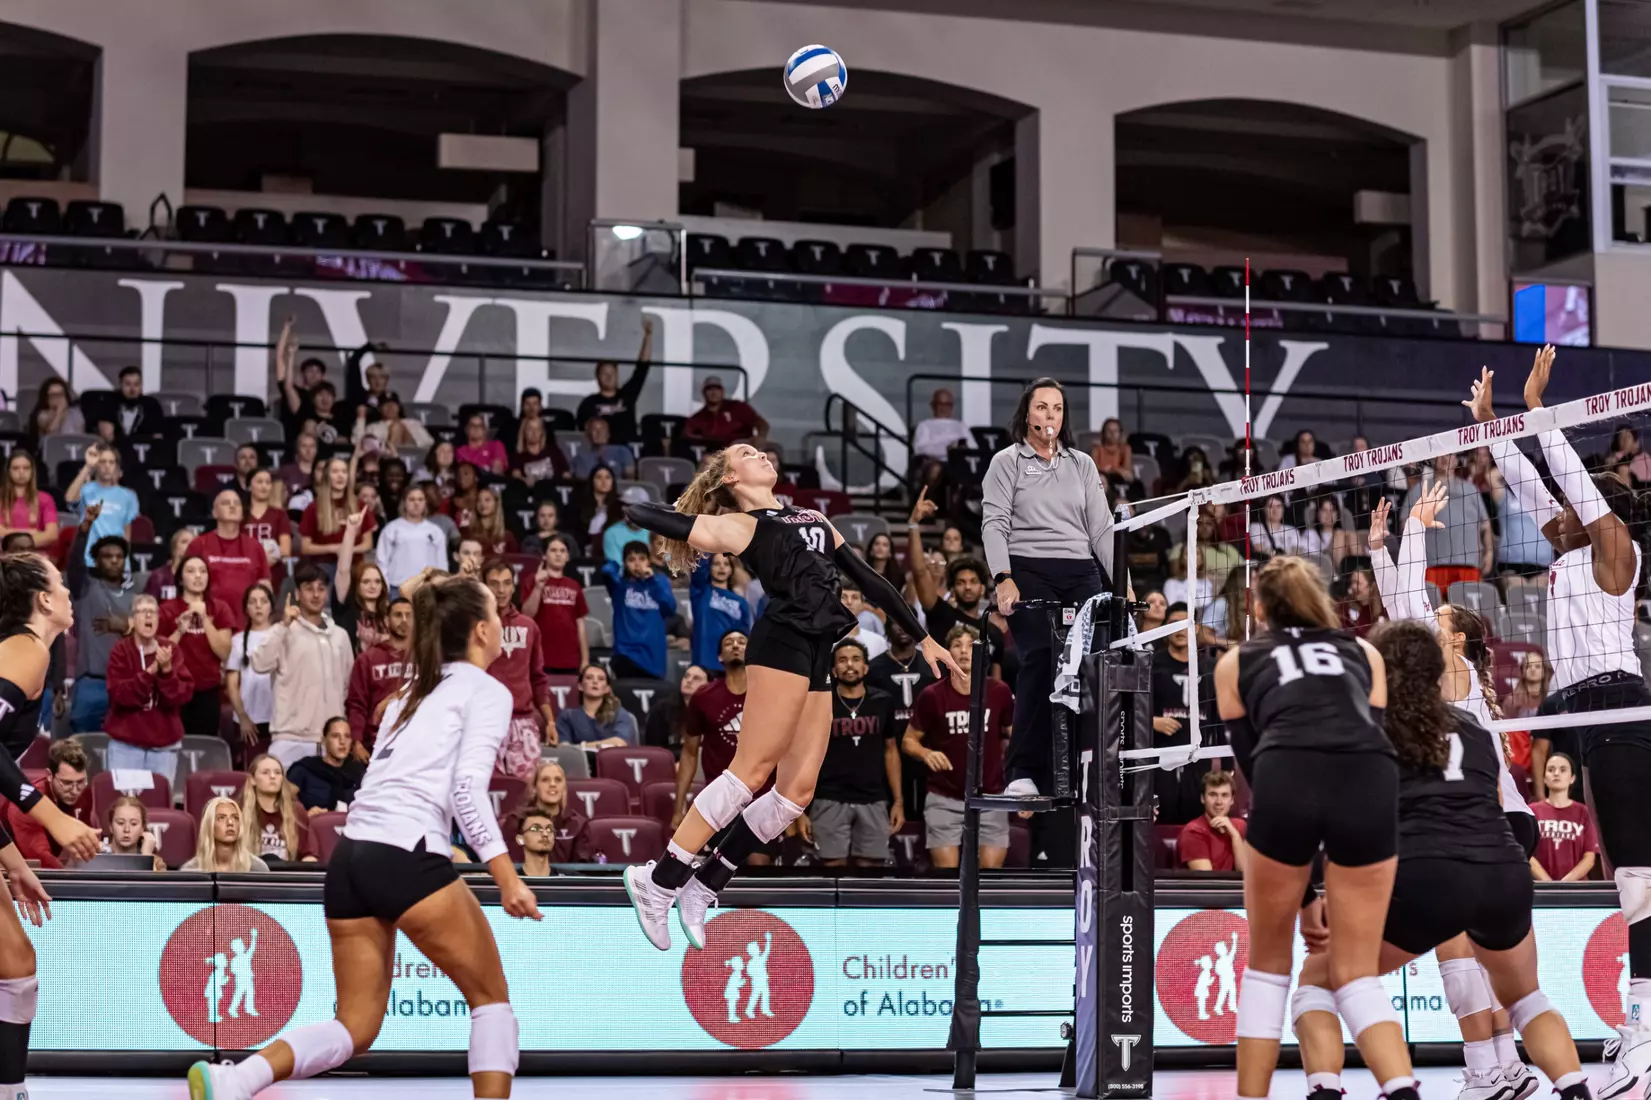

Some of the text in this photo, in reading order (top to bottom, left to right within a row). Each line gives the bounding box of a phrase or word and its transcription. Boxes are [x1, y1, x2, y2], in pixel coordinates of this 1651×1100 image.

[1585, 384, 1651, 416] TROY TROJAN
[1457, 414, 1525, 446] TROY TROJANS
[1343, 443, 1403, 472] TROY TROJANS
[1262, 468, 1295, 491] TROJANS
[798, 526, 826, 554] 10
[1270, 642, 1346, 686] 16
[890, 673, 921, 708] T
[1443, 733, 1465, 781] 1
[454, 774, 493, 849] TROJANS
[1537, 819, 1584, 837] TROY
[1079, 749, 1094, 999] TROY
[843, 954, 956, 979] Children'
[1119, 915, 1134, 1023] sports imports
[386, 990, 468, 1016] labam
[843, 989, 992, 1016] of Alabaa
[1110, 1033, 1142, 1072] T
